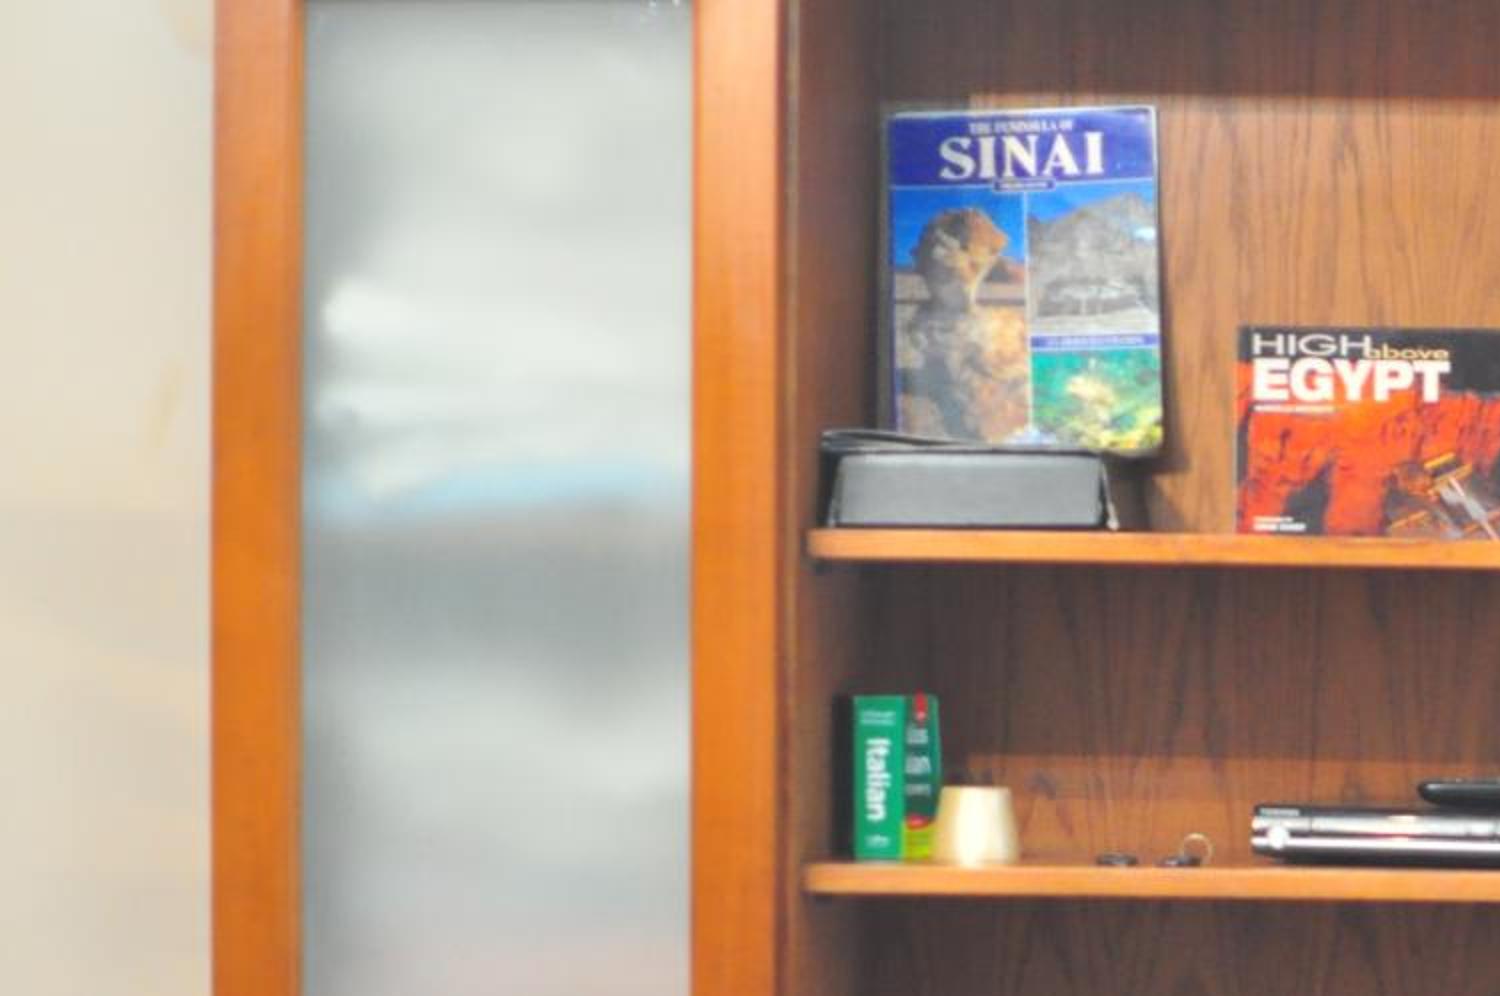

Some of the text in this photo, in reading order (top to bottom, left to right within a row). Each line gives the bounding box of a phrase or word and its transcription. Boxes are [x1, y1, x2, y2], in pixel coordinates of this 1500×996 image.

[939, 131, 1105, 179] SINAI
[1252, 333, 1450, 359] HIGH above
[1252, 357, 1452, 402] EGYPT
[865, 737, 892, 822] Italian
